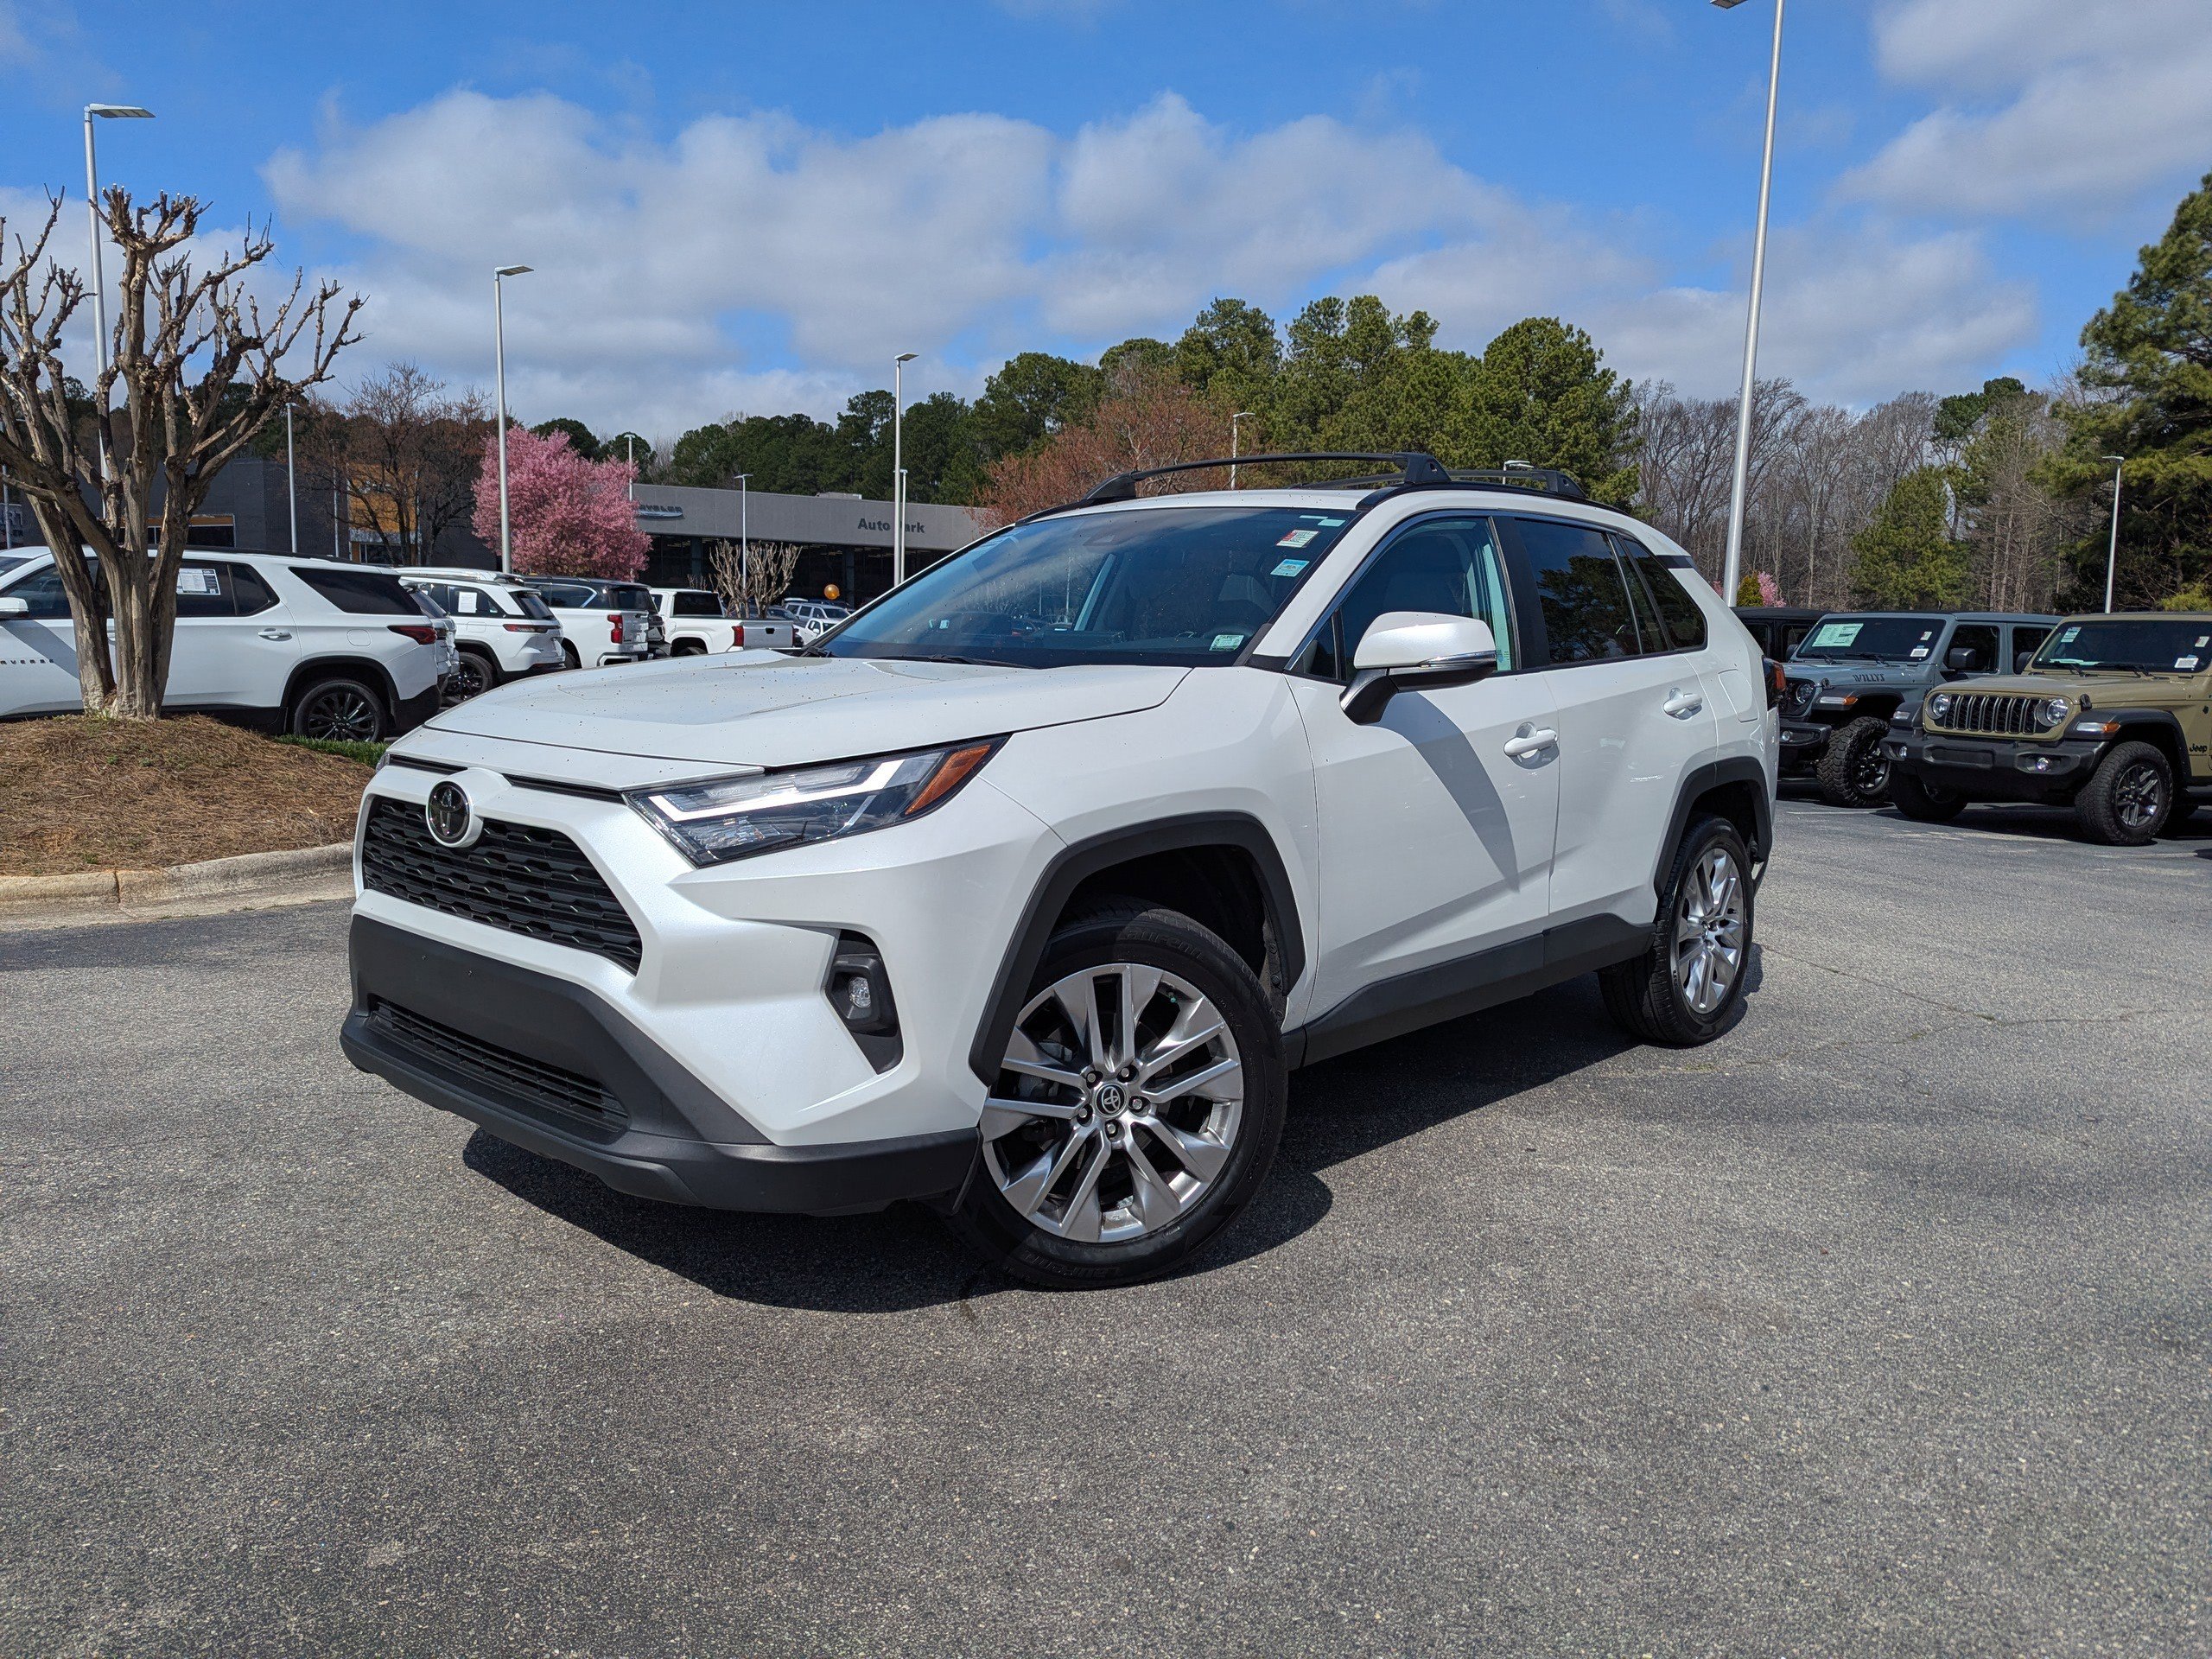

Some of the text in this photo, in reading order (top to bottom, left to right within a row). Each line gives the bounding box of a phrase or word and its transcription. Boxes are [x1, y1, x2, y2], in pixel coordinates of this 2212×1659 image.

[857, 518, 891, 531] Auto
[1852, 673, 1885, 682] WILLYS
[2189, 743, 2208, 753] Jeep
